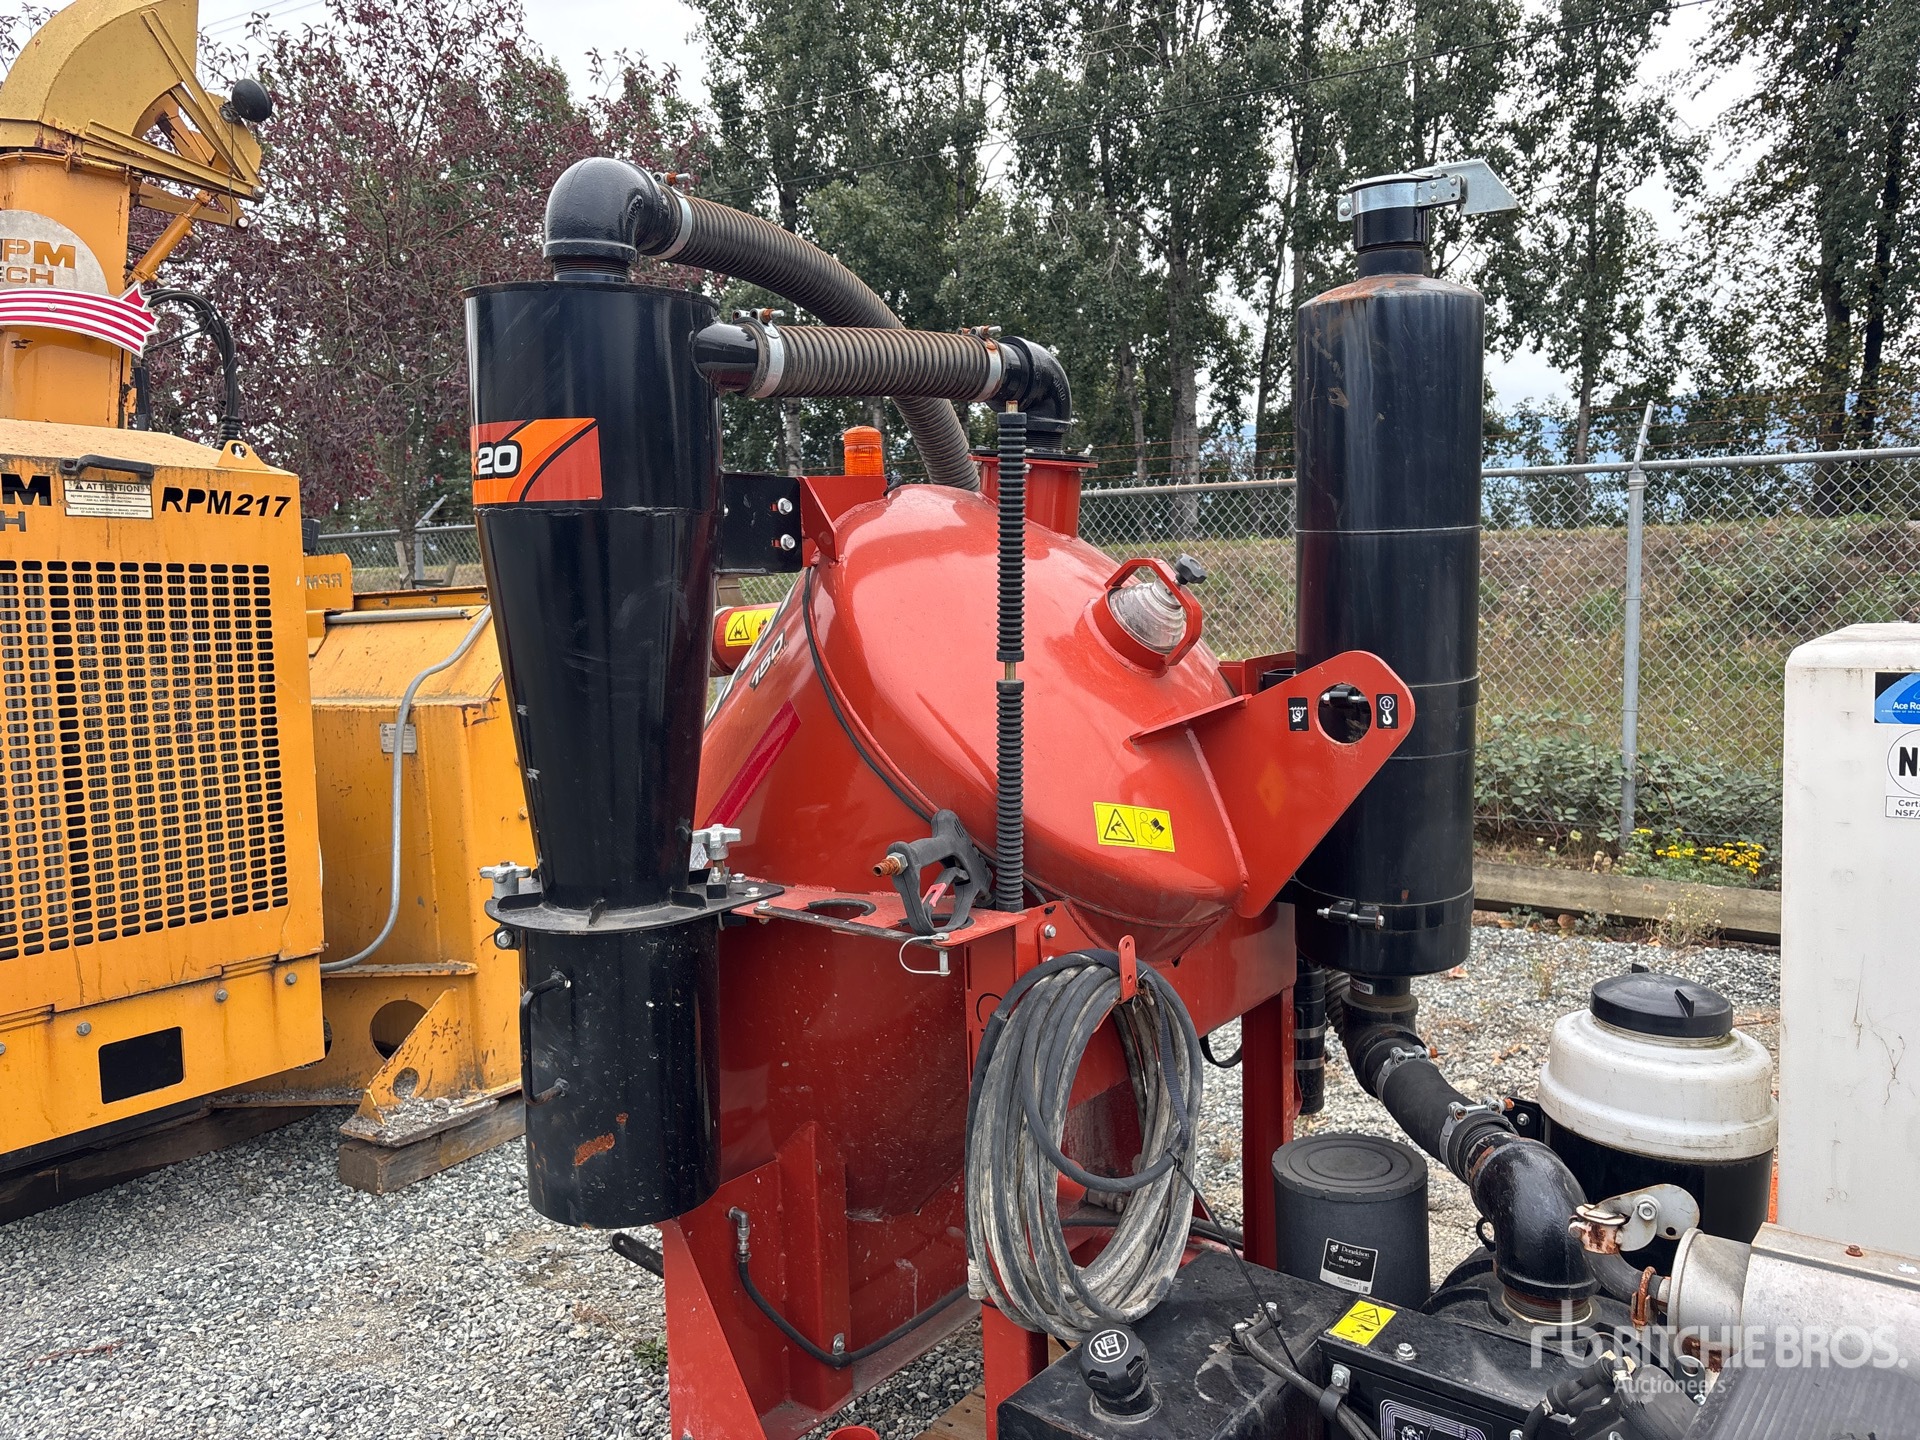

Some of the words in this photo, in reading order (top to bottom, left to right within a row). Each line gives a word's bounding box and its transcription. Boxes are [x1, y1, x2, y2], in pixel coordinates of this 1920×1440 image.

[0, 265, 55, 286] CH
[0, 473, 53, 507] M
[86, 482, 141, 493] ATTENTION
[0, 510, 27, 533] H
[751, 631, 785, 687] 150
[1893, 702, 1909, 710] Ace
[1899, 746, 1920, 777] N
[1341, 1246, 1370, 1257] Donaldson
